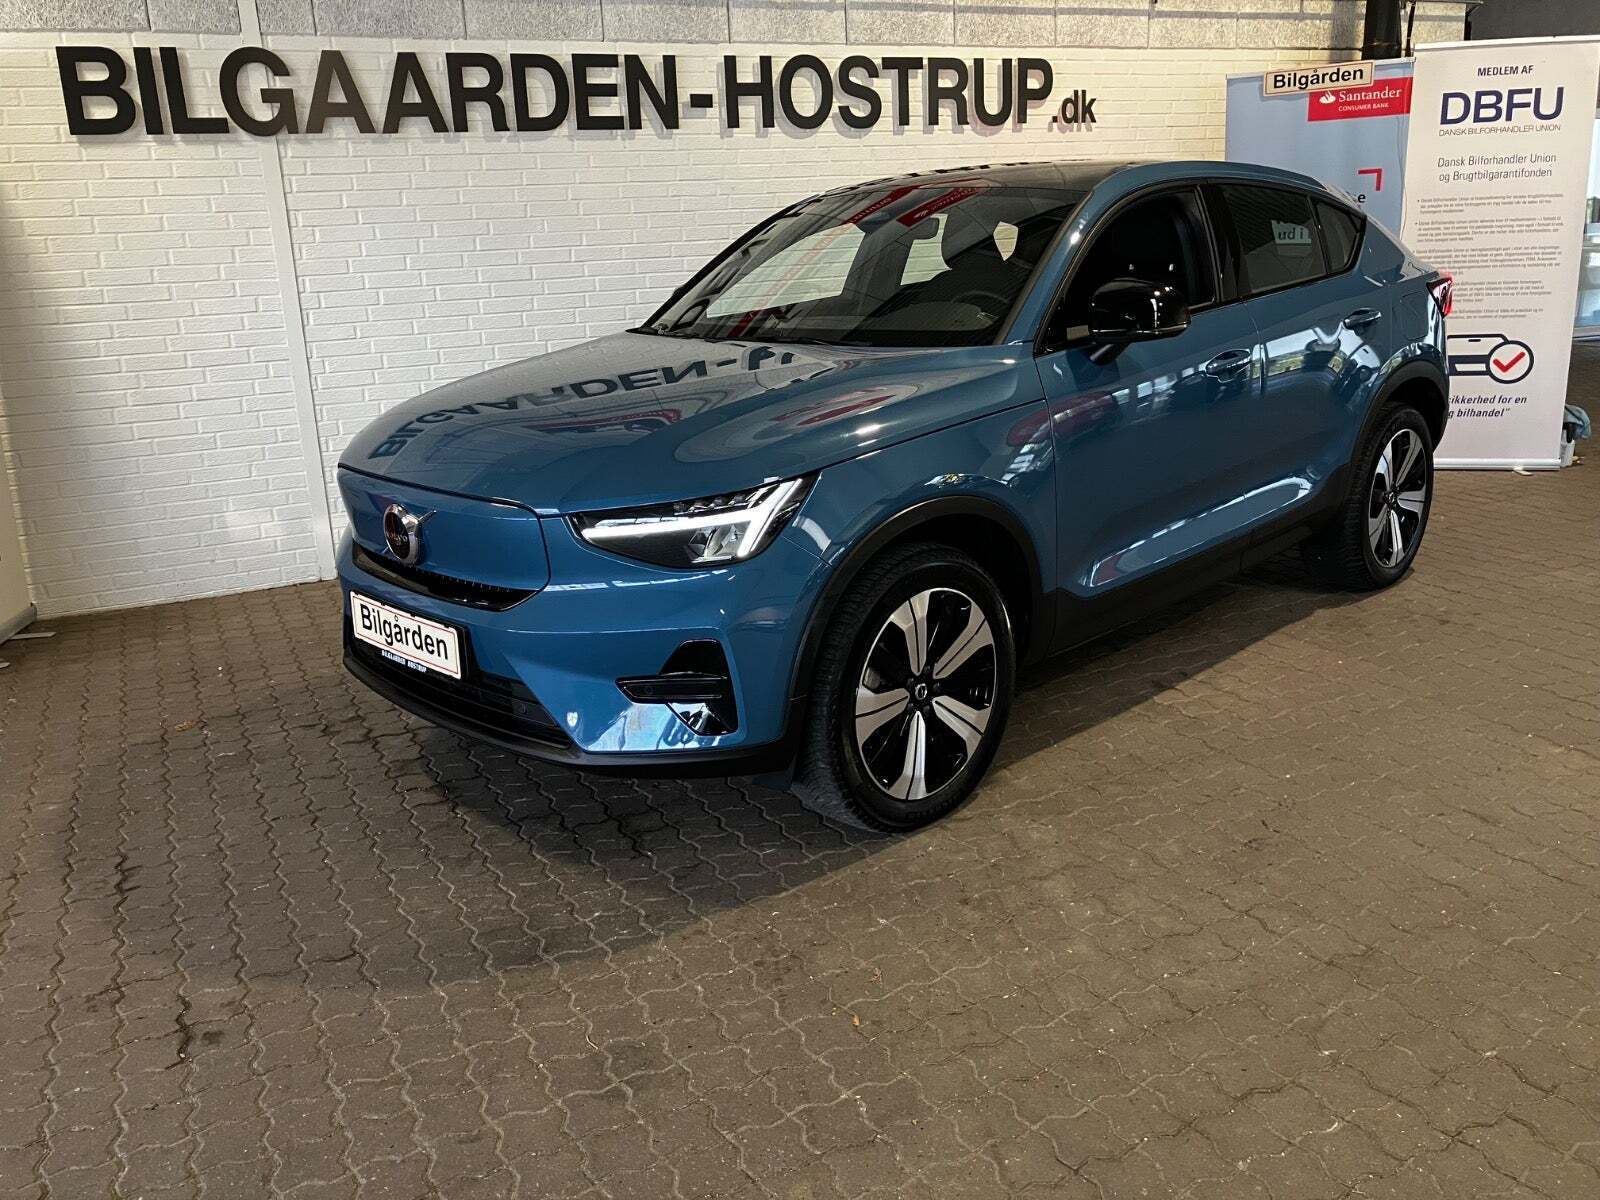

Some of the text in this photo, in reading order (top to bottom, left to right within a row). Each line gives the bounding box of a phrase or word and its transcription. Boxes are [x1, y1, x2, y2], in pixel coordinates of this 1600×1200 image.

[1477, 65, 1534, 76] MEDLEM AF
[1273, 68, 1364, 90] Bilgården
[1338, 86, 1402, 102] Santander
[1338, 103, 1371, 111] CONSUMER
[1440, 86, 1565, 125] DBFU
[1439, 124, 1561, 136] DANSK BILFORHANDLER UNION
[1438, 153, 1557, 167] Dansk Bilforhandler Union
[1439, 168, 1552, 183] og Brugtbilgarantifonden
[1449, 394, 1527, 404] ikkerhed for en
[360, 603, 448, 660] Bilgården
